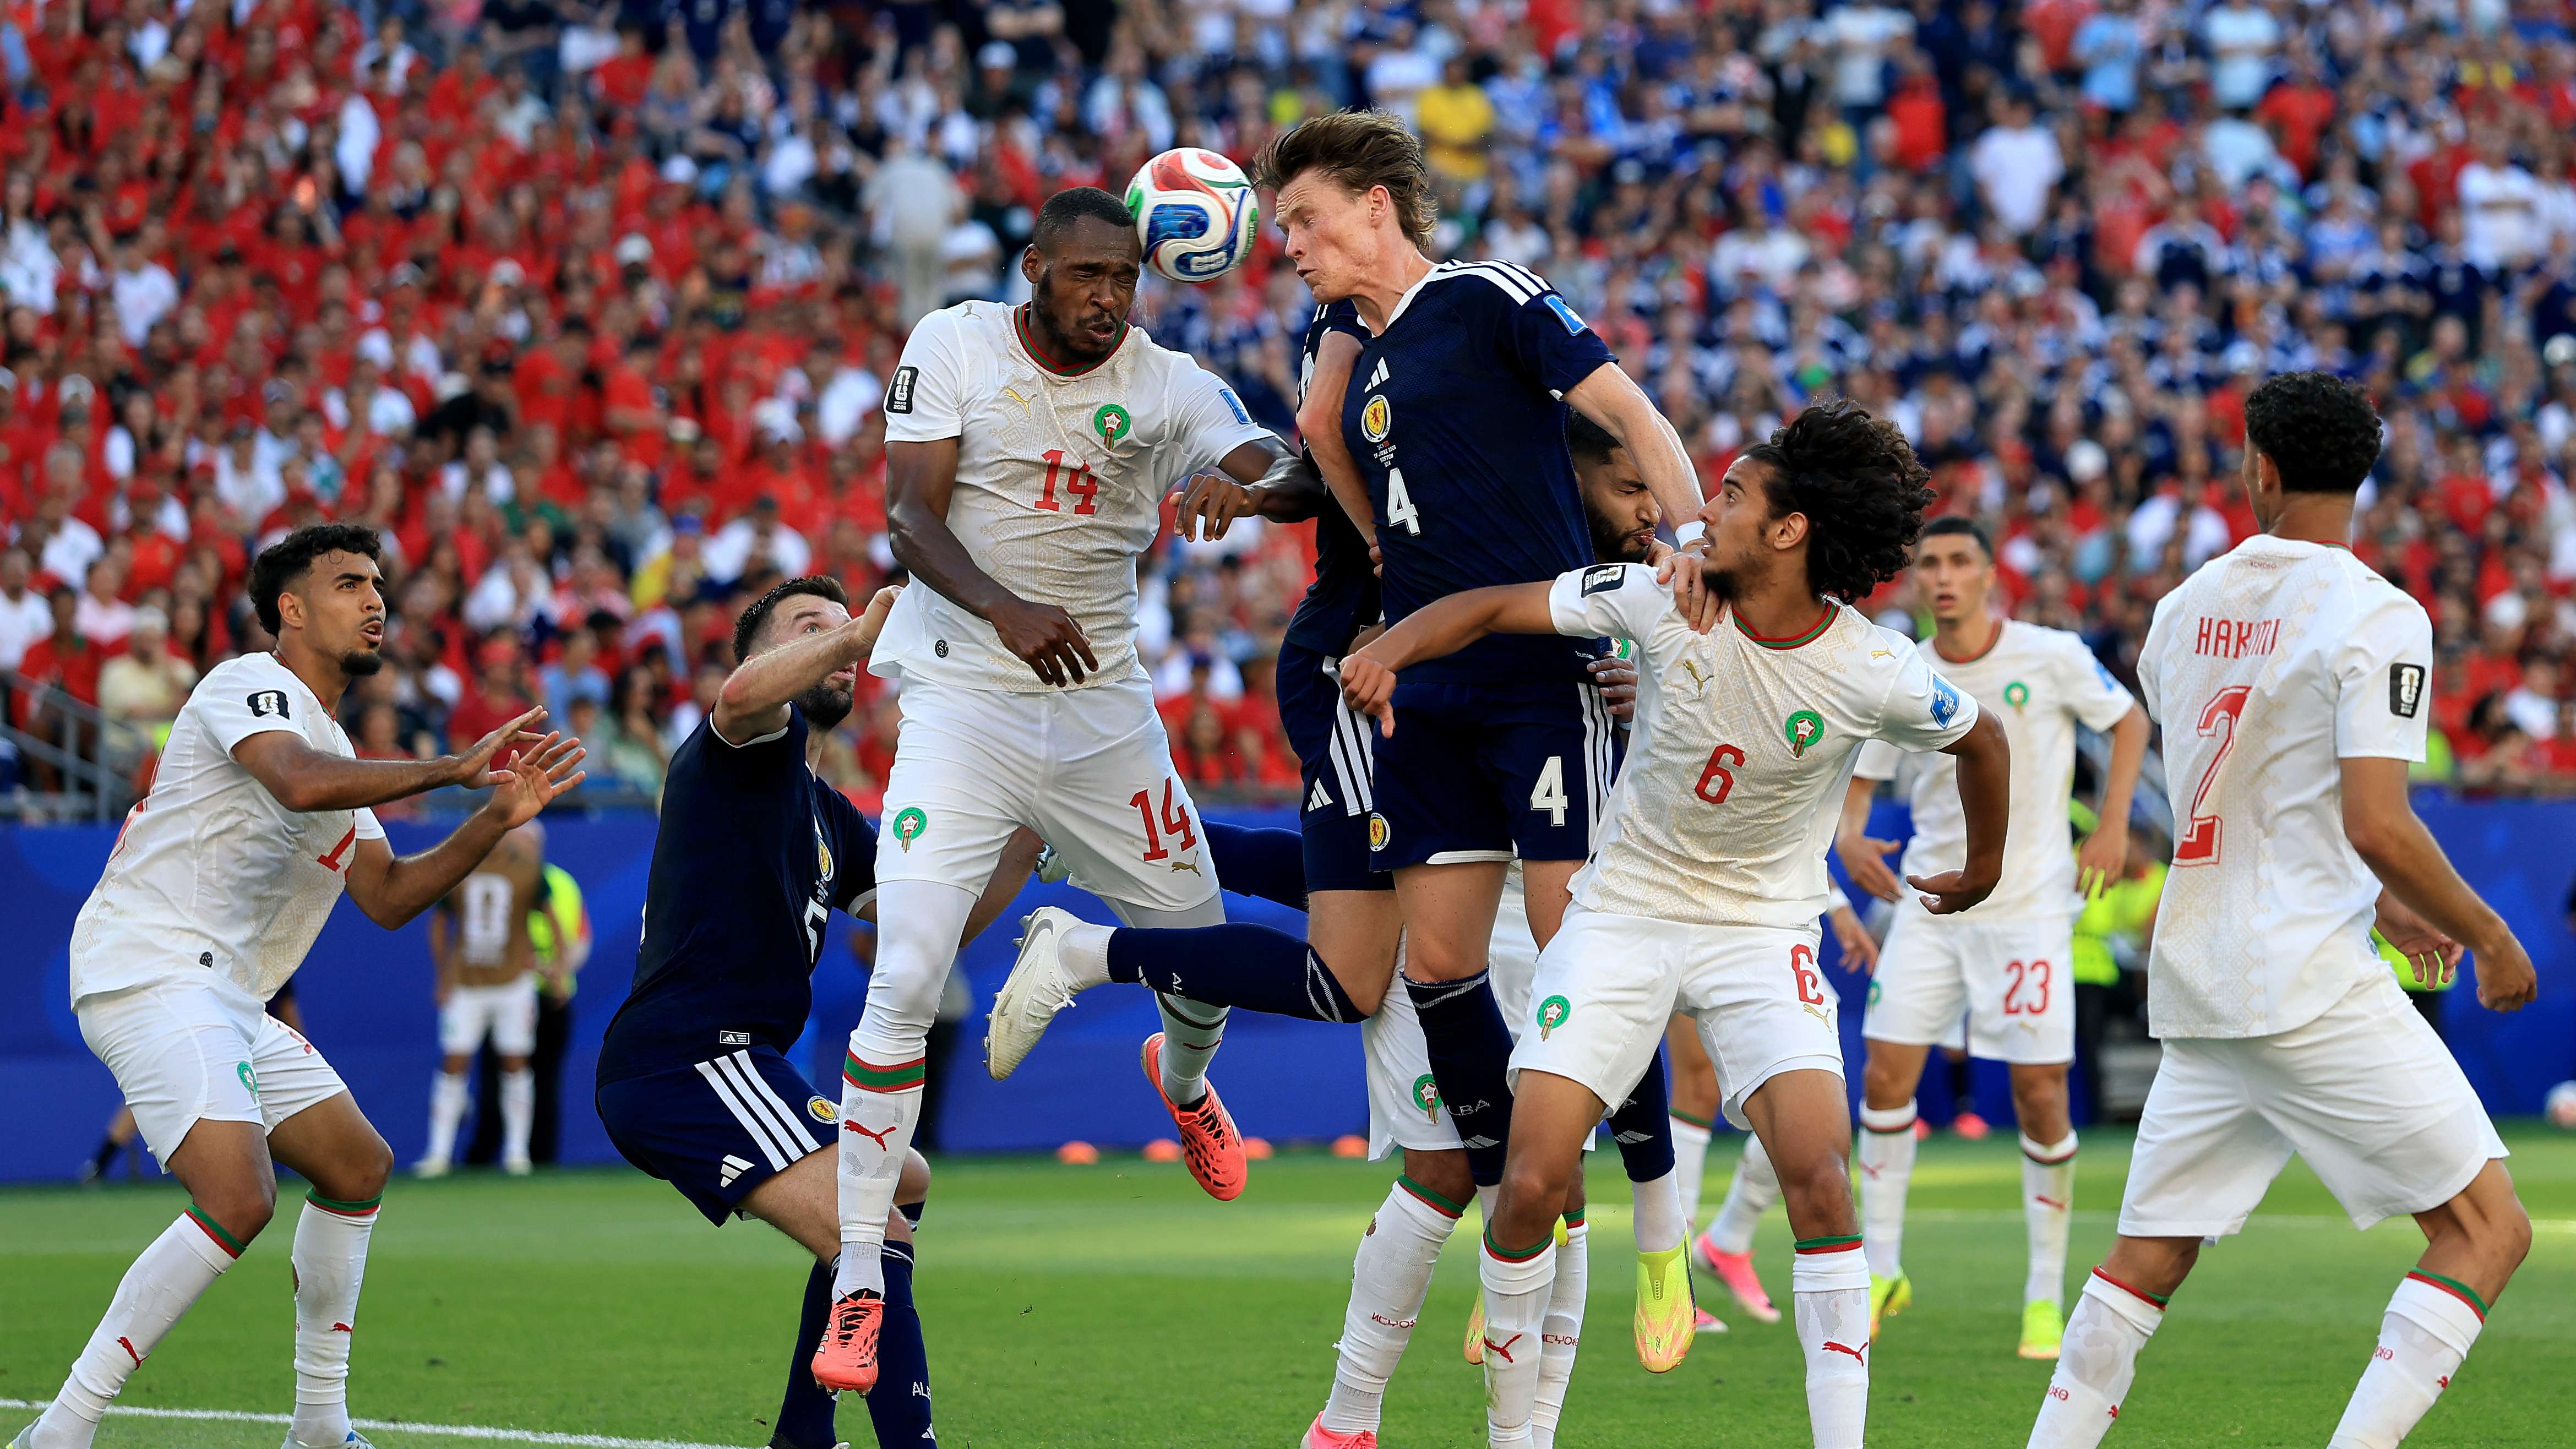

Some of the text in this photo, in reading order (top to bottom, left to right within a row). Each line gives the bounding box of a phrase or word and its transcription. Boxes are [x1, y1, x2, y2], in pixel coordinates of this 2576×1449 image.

[1035, 450, 1098, 514] 14
[1387, 467, 1420, 536] 4
[1530, 756, 1569, 827] 4
[1695, 743, 1745, 805] 6
[2172, 685, 2223, 867] 2
[1131, 776, 1196, 862] 14
[1791, 944, 1824, 1005] 6
[2003, 960, 2051, 1015] 23
